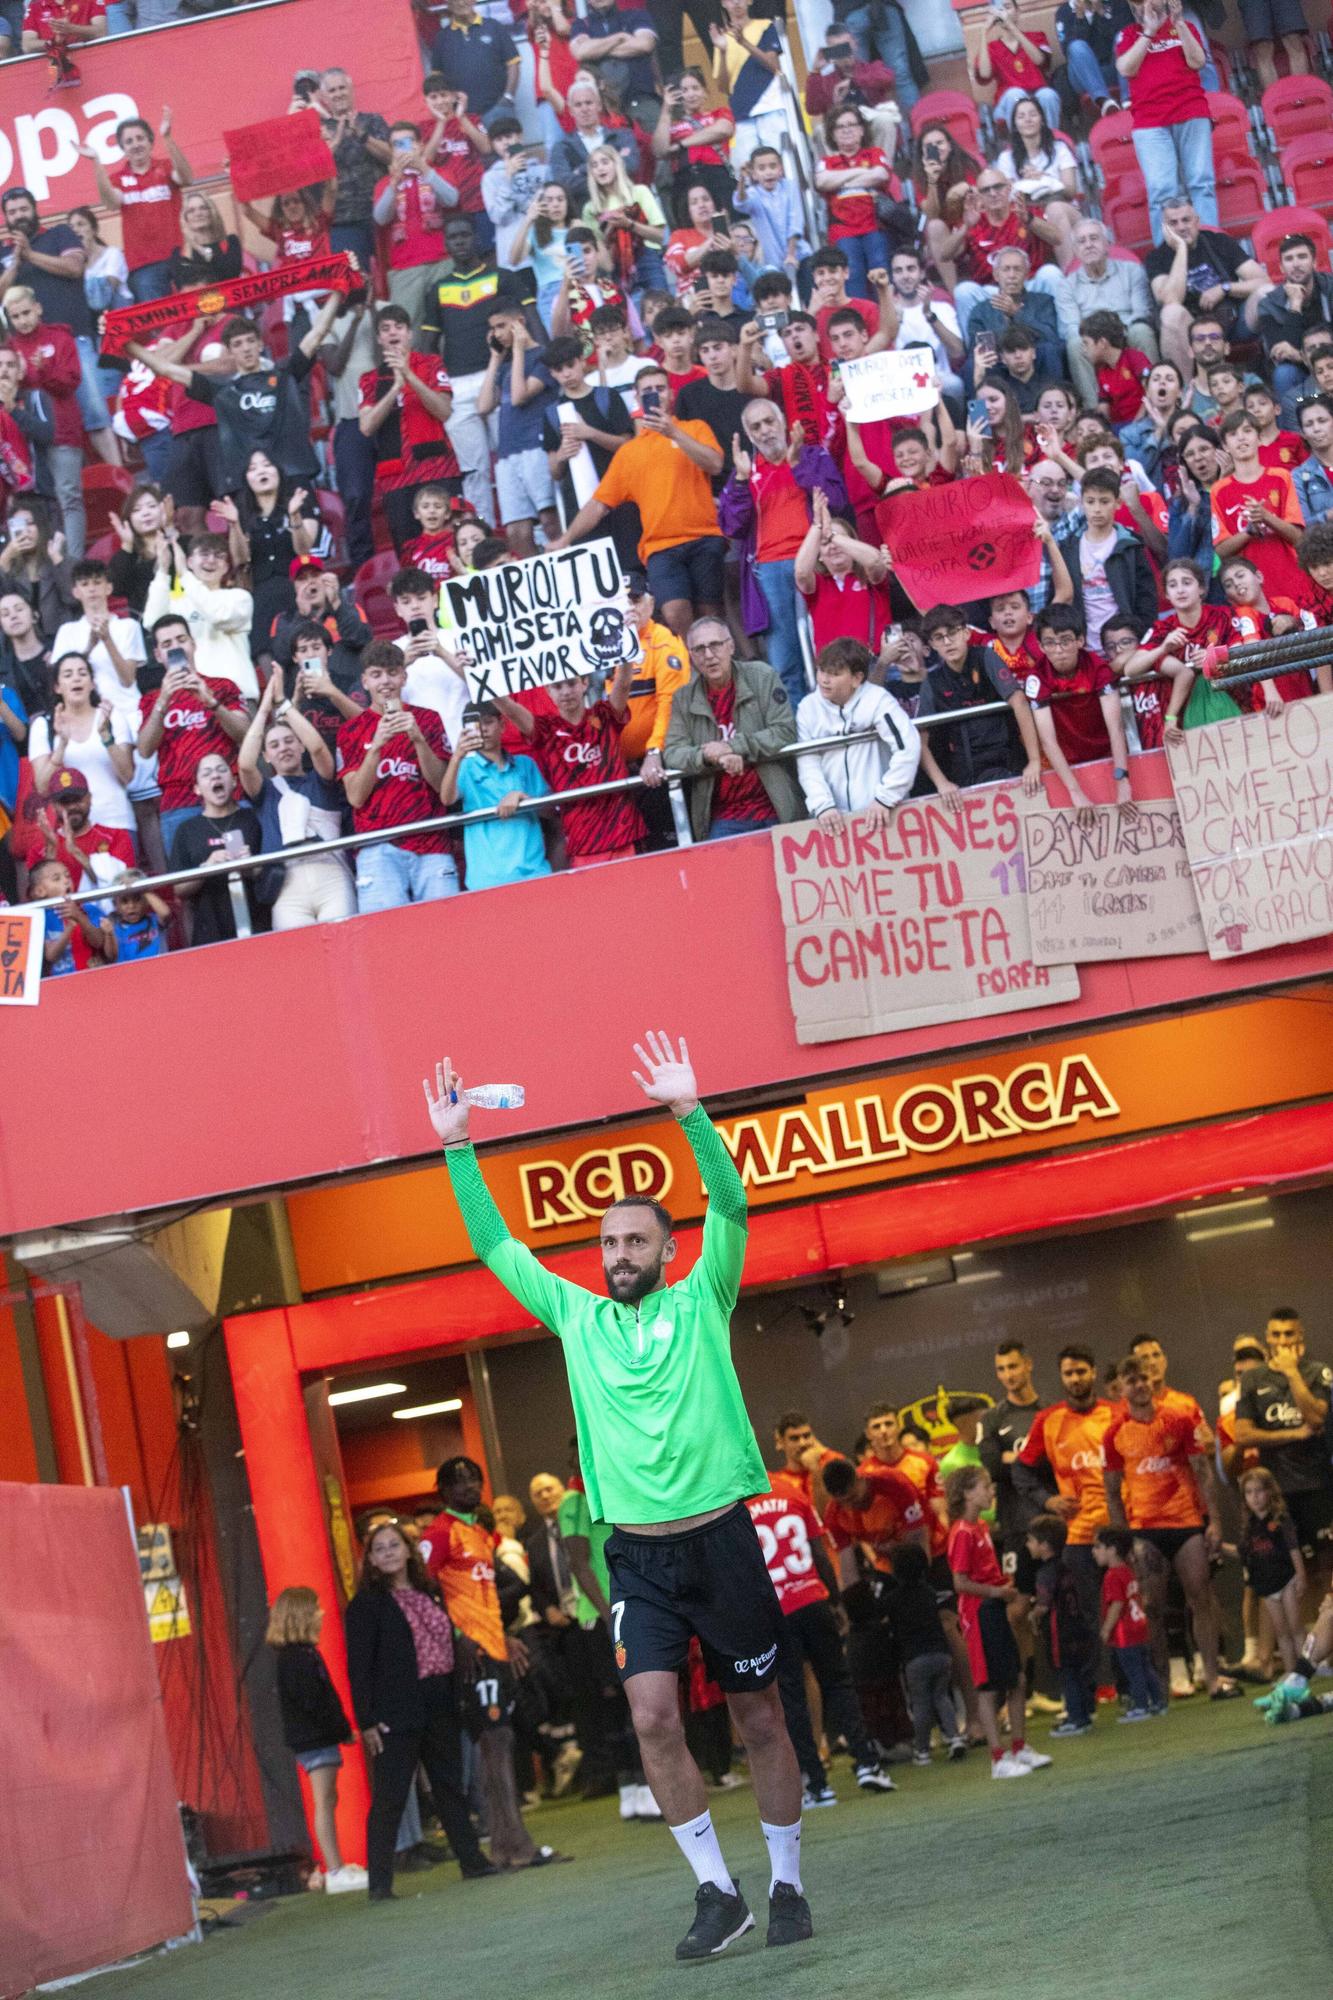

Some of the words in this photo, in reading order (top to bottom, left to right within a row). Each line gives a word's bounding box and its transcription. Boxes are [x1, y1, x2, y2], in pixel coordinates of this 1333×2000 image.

[0, 92, 140, 202] pa
[558, 547, 620, 605] TU
[470, 669, 499, 701] X
[501, 645, 580, 694] FAVOR
[1166, 702, 1320, 780] MAFFEO
[1177, 767, 1275, 824] DAME
[1278, 758, 1333, 802] TU
[781, 794, 1020, 875] MURLANES
[791, 868, 896, 926] DAME
[903, 860, 964, 912] TU
[1195, 856, 1252, 902] POR
[977, 960, 1050, 998] PORFA
[519, 1142, 673, 1229] RCD
[701, 1053, 1121, 1197] MALLORCA
[755, 1514, 813, 1584] 23
[611, 1601, 625, 1643] 7
[475, 1679, 499, 1706] 17
